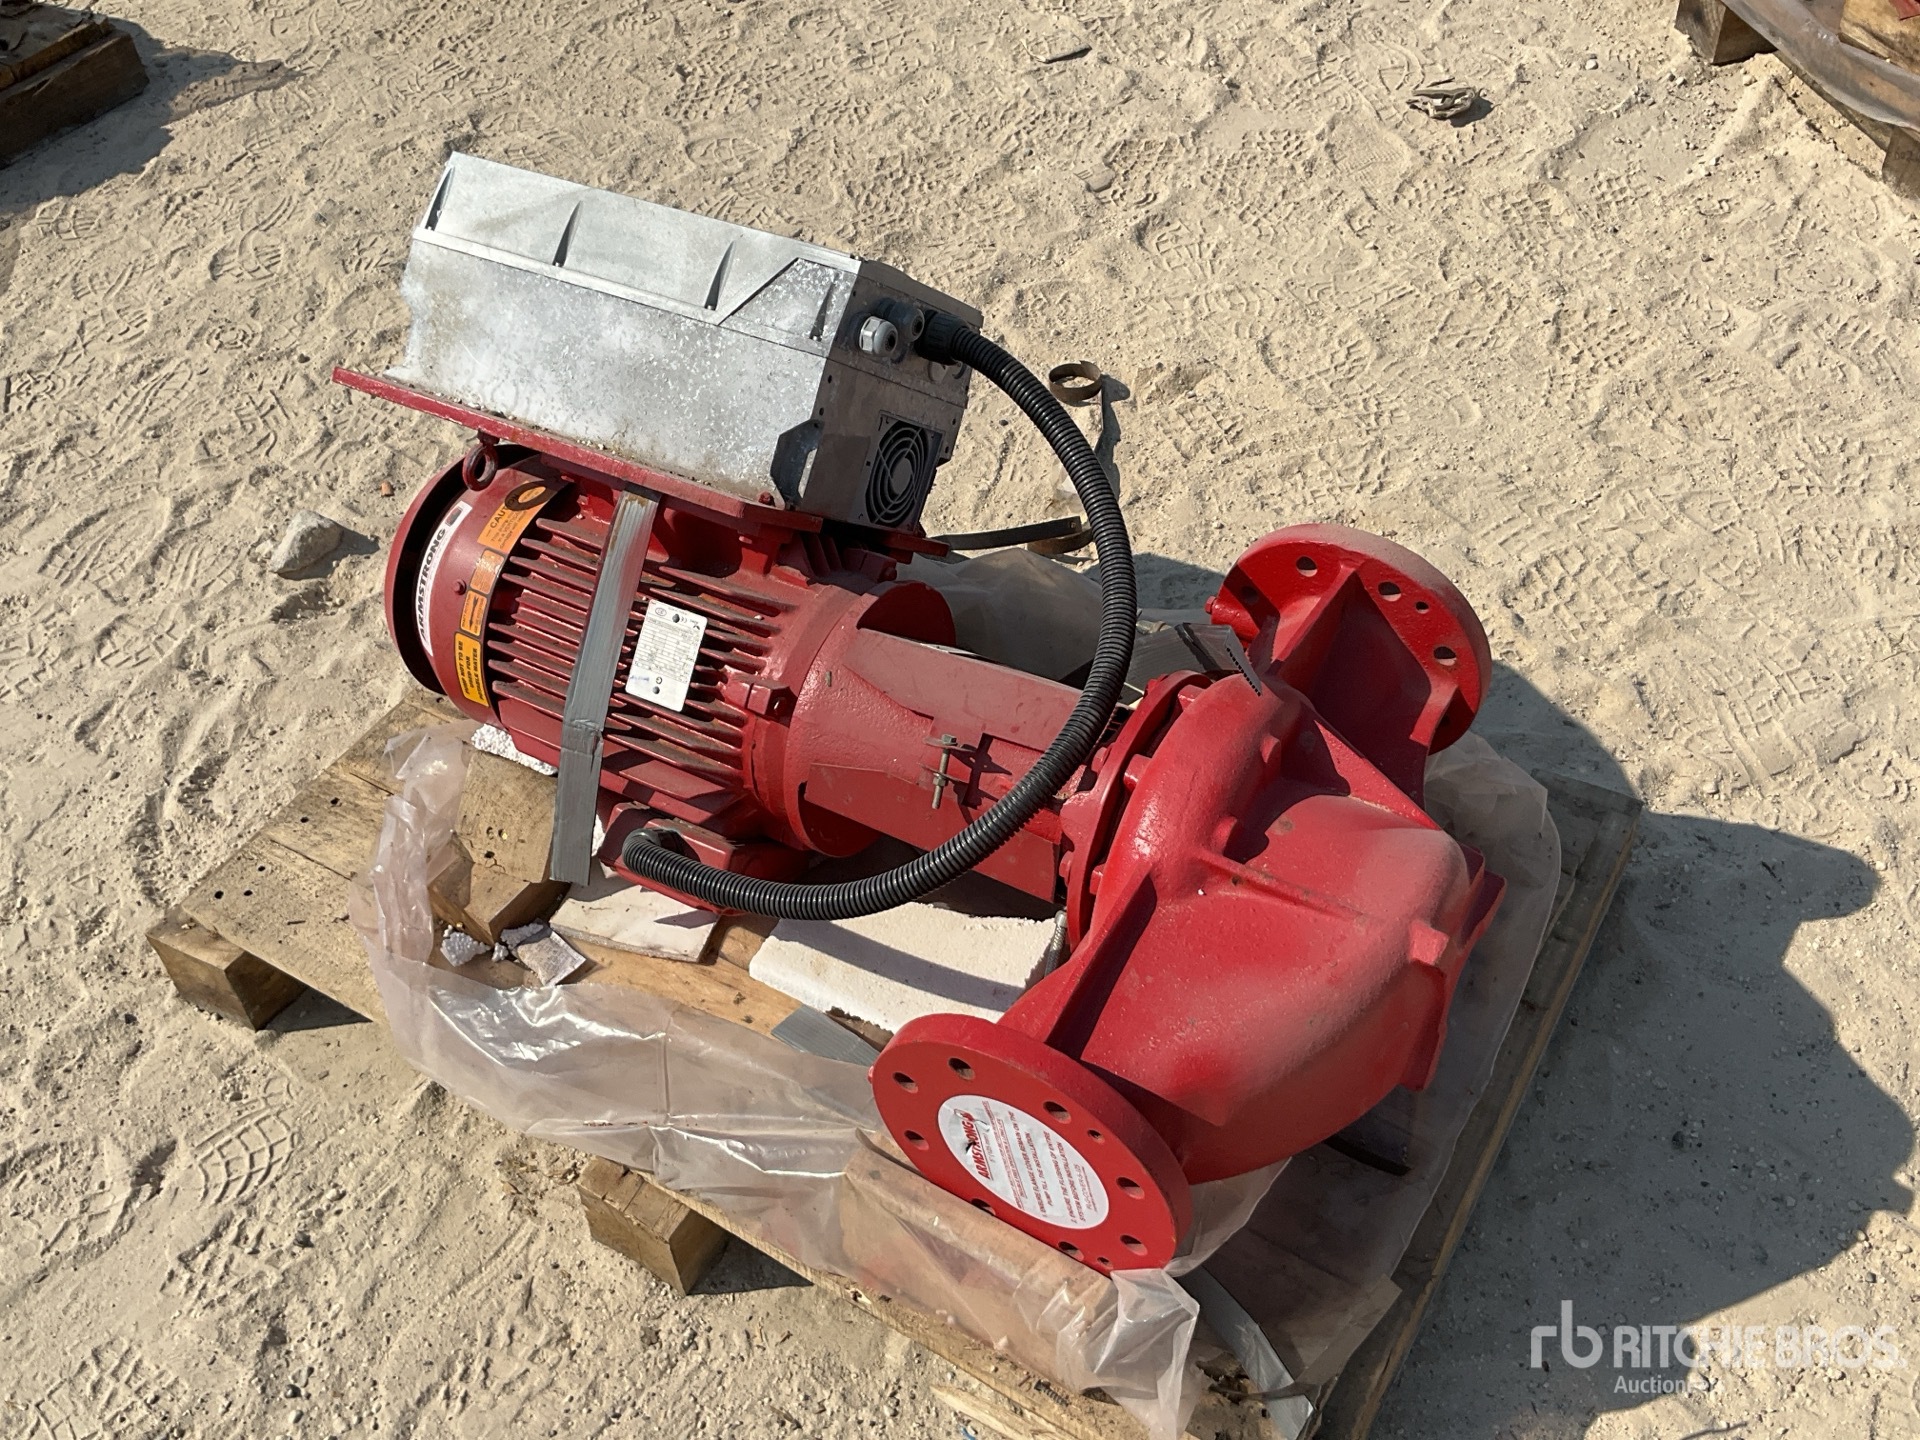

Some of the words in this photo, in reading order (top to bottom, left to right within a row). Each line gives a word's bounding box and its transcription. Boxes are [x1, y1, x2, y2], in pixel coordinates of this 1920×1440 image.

[416, 528, 446, 642] ARMSTRONG
[459, 641, 463, 650] BE
[458, 652, 463, 661] TO
[461, 677, 470, 694] PUMP
[1008, 1111, 1016, 1122] THE
[1012, 1122, 1019, 1131] ON
[1015, 1131, 1026, 1152] REMAIN
[1043, 1131, 1054, 1151] ENTIRE
[1022, 1152, 1033, 1171] COVER
[1050, 1151, 1056, 1159] OF
[1055, 1141, 1072, 1179] INSTALLATION
[1028, 1171, 1040, 1192] FLANGE
[1052, 1159, 1065, 1185] FLUSHING
[1040, 1179, 1048, 1191] TILL
[1067, 1178, 1079, 1200] BEFORE
[1035, 1192, 1047, 1213] ENSURE
[1044, 1191, 1053, 1206] PUMP
[1064, 1197, 1075, 1218] ENSURE
[1074, 1200, 1085, 1221] SYSTEM
